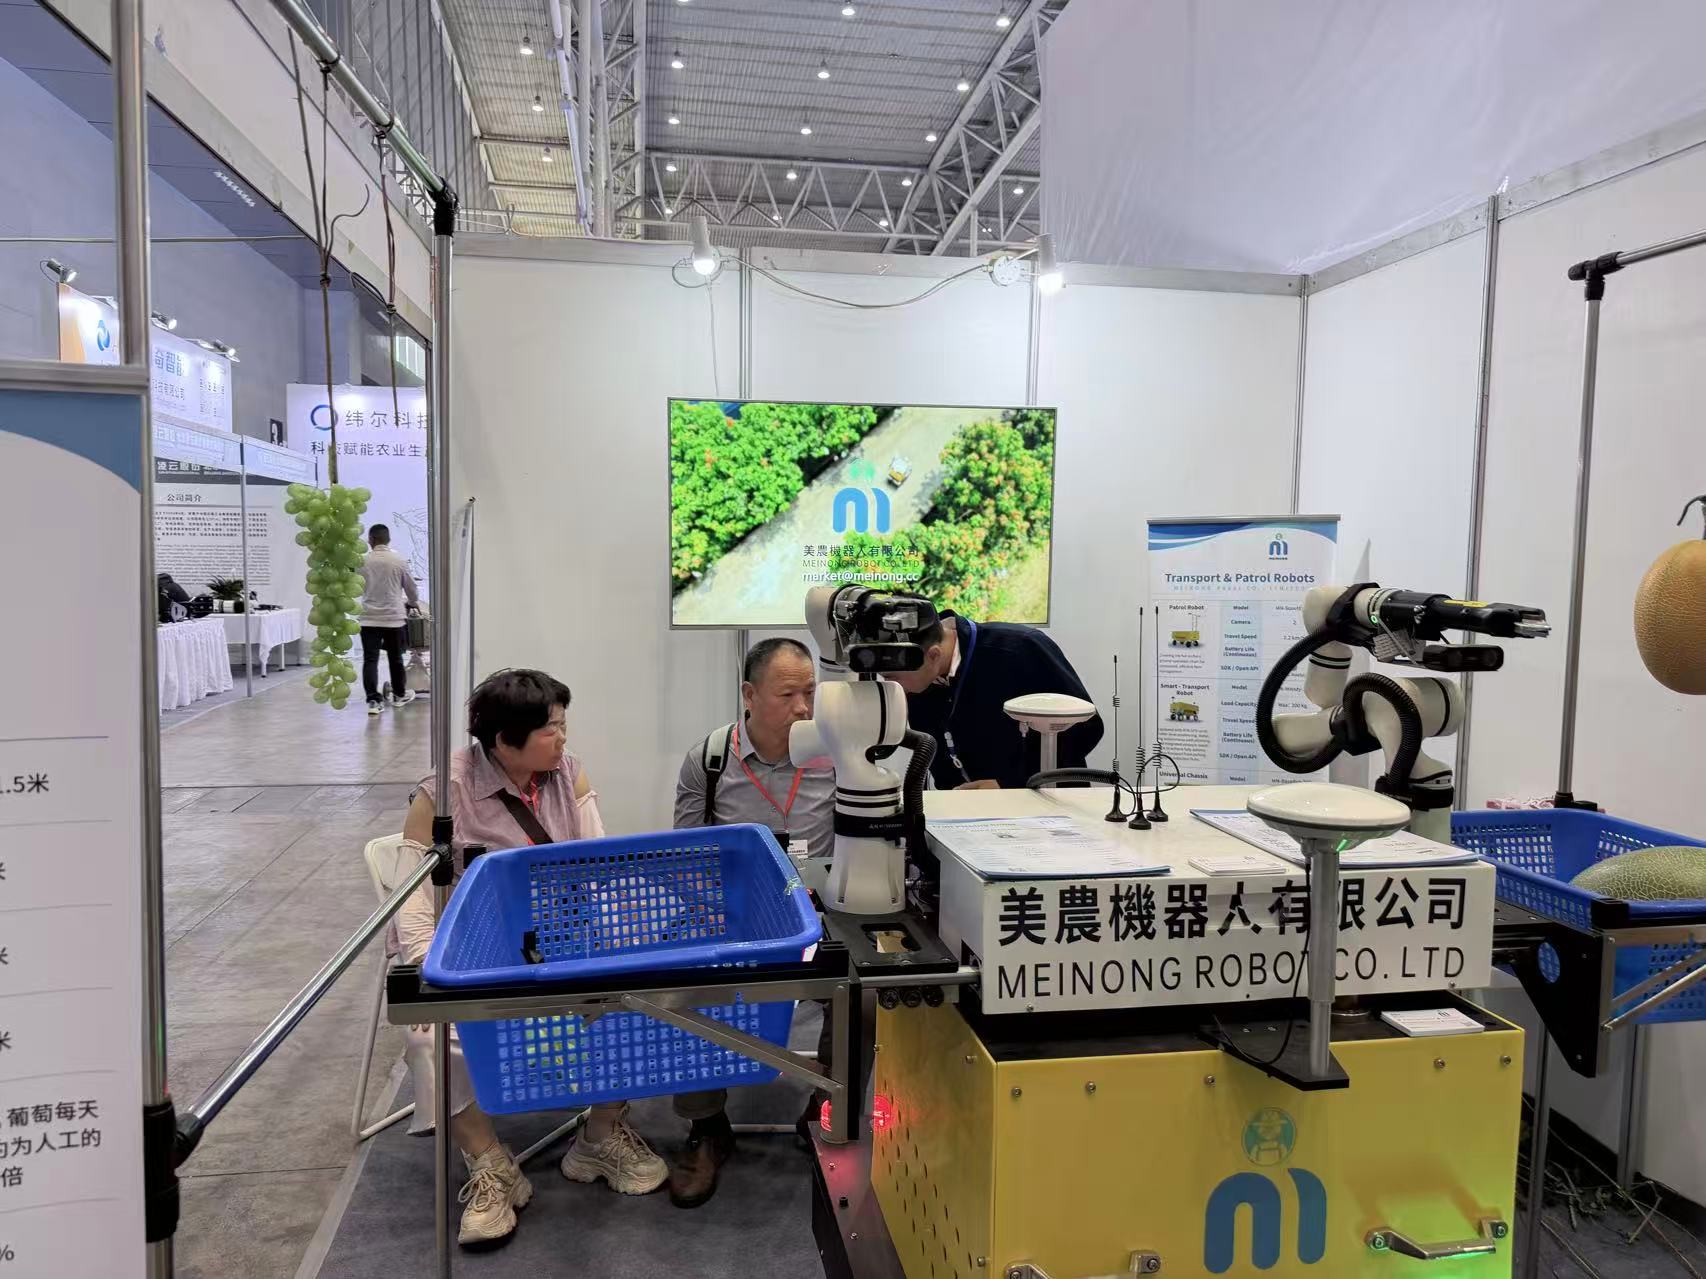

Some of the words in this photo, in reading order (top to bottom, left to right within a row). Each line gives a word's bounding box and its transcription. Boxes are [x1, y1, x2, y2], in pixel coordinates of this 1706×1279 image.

[310, 440, 427, 458] 科赋能农业生
[167, 493, 202, 503] 公司简介
[803, 544, 919, 557] 美農機器人有限公司
[1165, 573, 1220, 584] Transport
[1223, 573, 1232, 583] &
[1235, 573, 1271, 583] Patrol
[1273, 573, 1315, 583] Robots
[998, 876, 1467, 947] 美農機器人有限公司
[998, 955, 1182, 1000] MEINONG
[1195, 950, 1309, 989] ROBO
